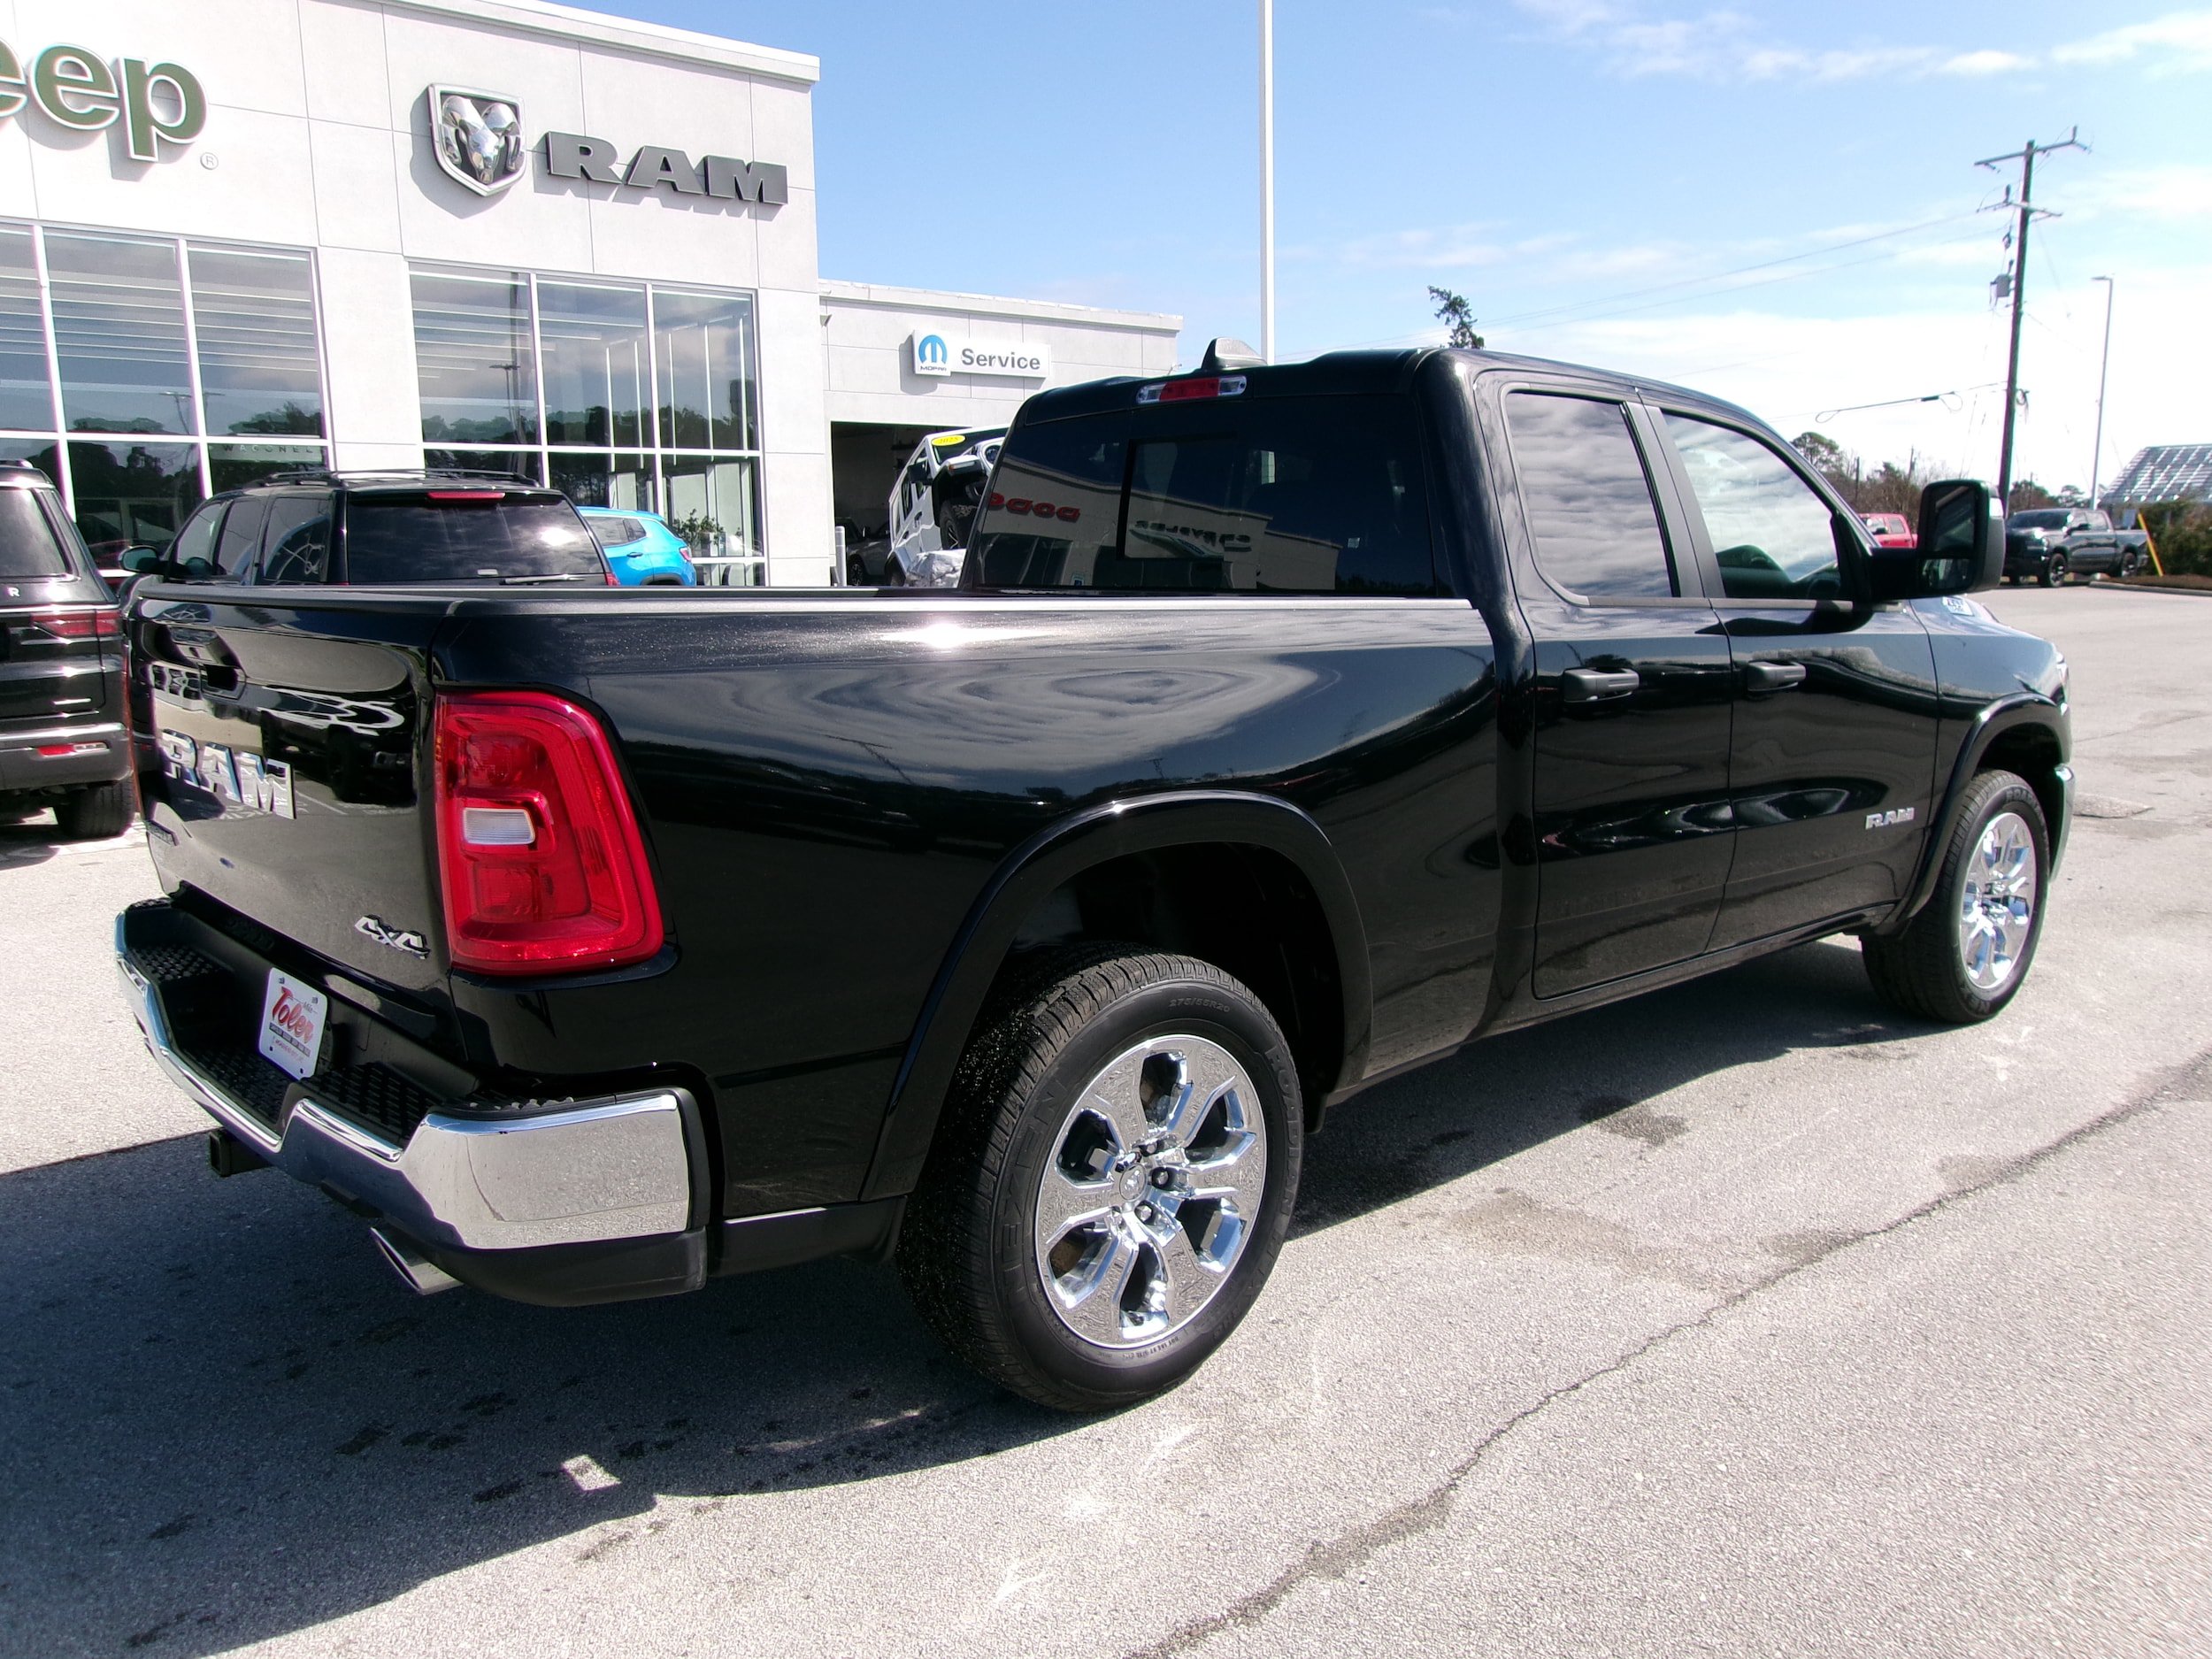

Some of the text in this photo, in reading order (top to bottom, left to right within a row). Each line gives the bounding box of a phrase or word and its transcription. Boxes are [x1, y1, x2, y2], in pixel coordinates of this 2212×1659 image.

[545, 131, 788, 205] RAM
[961, 348, 1041, 370] Service
[160, 729, 296, 819] RAM
[1865, 807, 1915, 829] RAM
[272, 987, 315, 1044] Toler
[1002, 1078, 1067, 1302] NEXEN
